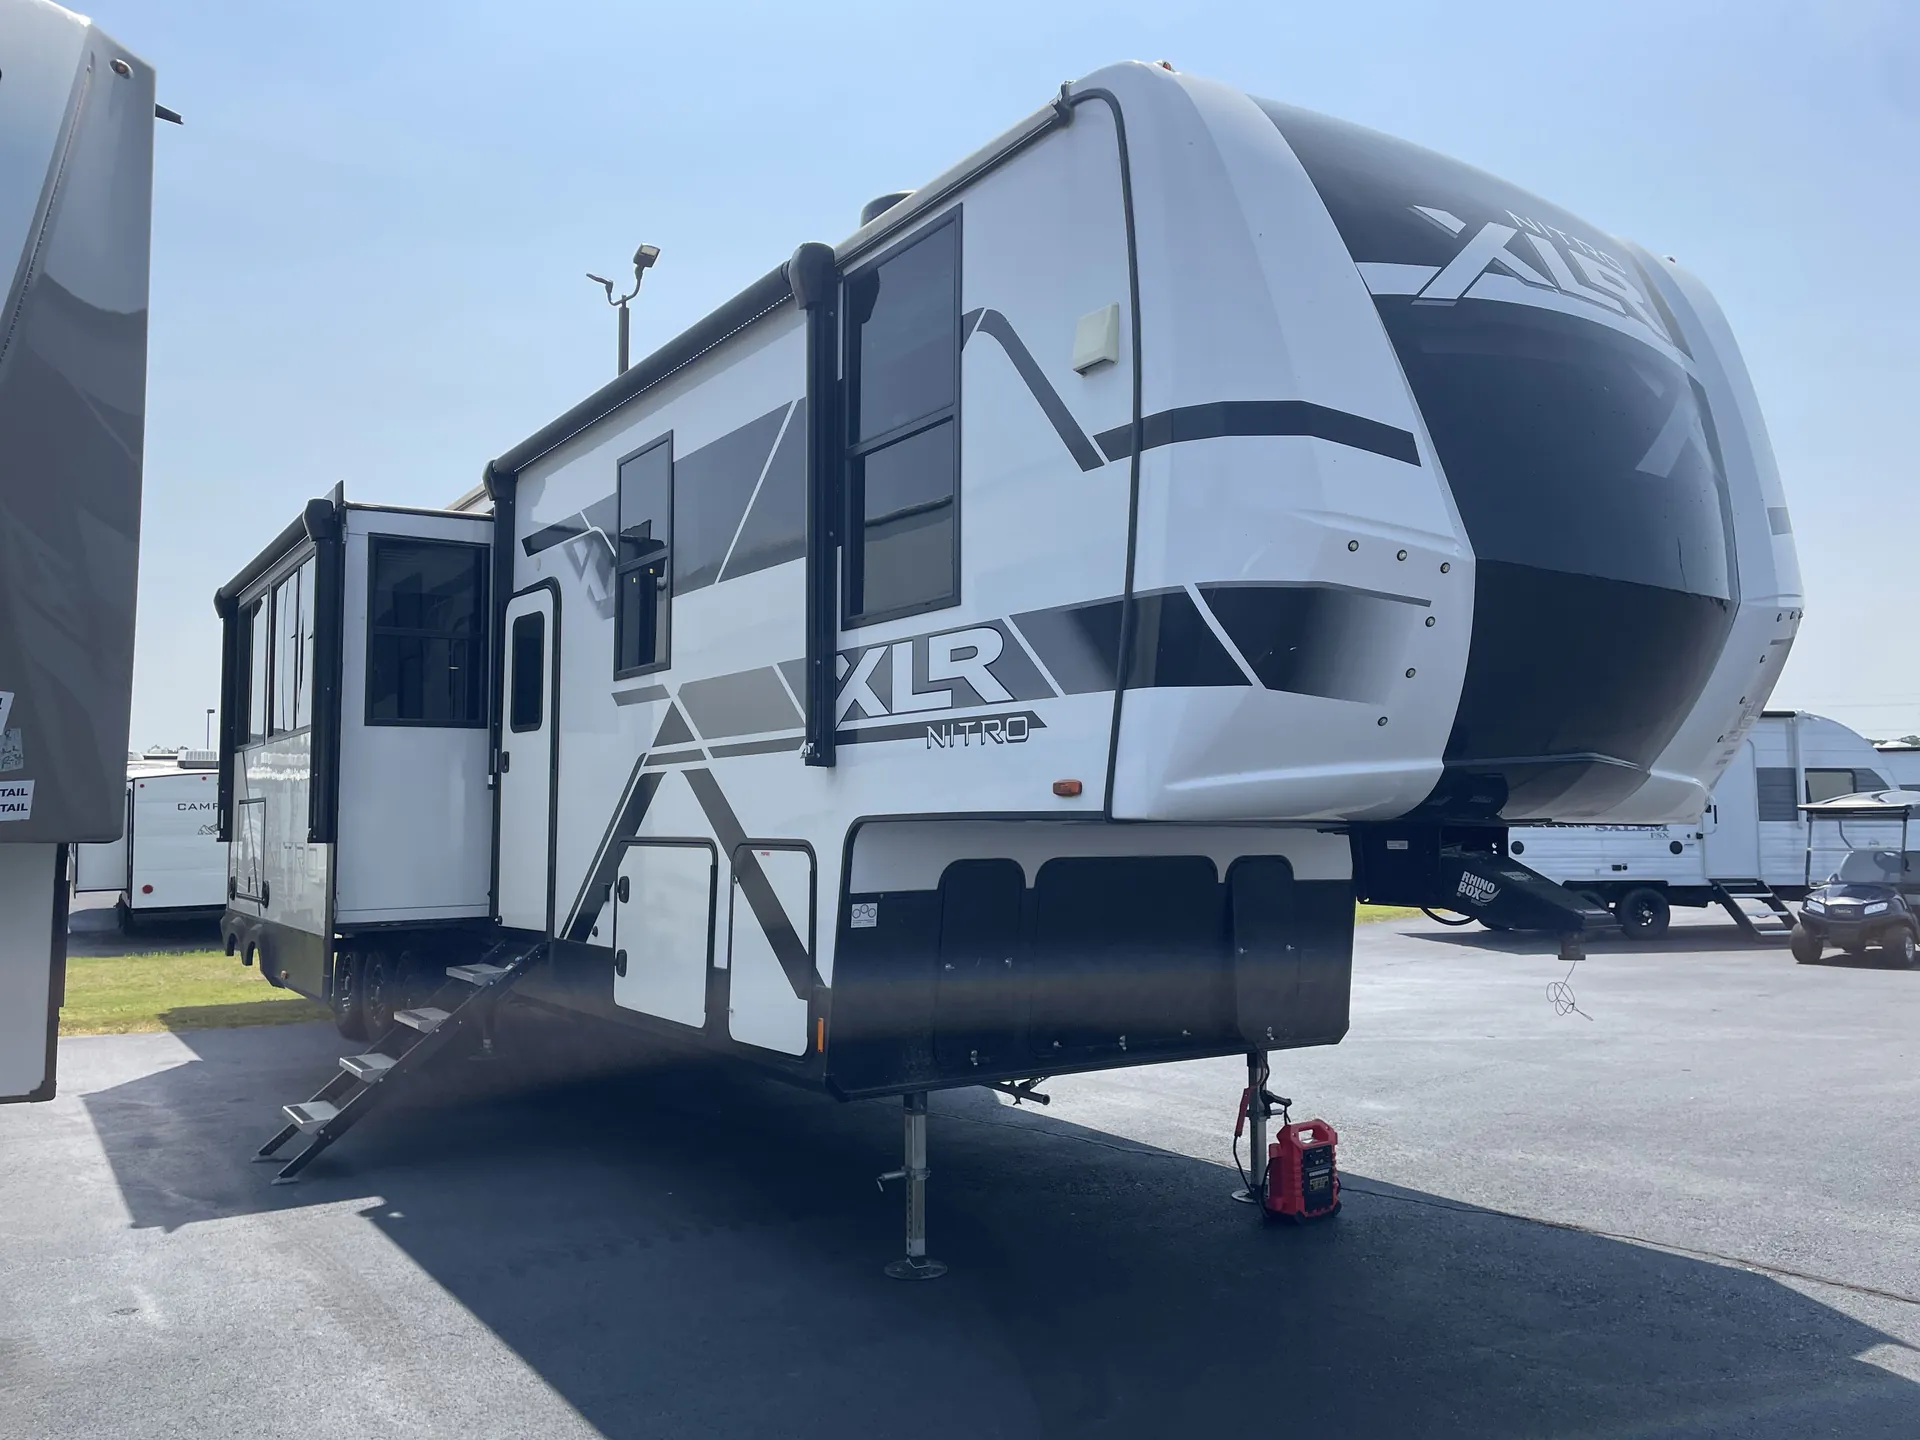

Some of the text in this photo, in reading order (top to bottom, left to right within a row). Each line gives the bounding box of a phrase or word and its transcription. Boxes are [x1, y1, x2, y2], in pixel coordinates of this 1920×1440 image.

[1505, 209, 1626, 274] NITRO
[1408, 204, 1672, 344] XLR
[836, 626, 1015, 730] XLR
[927, 715, 1029, 749] NITRO
[1457, 882, 1482, 900] BOX
[1461, 871, 1496, 894] RHINO
